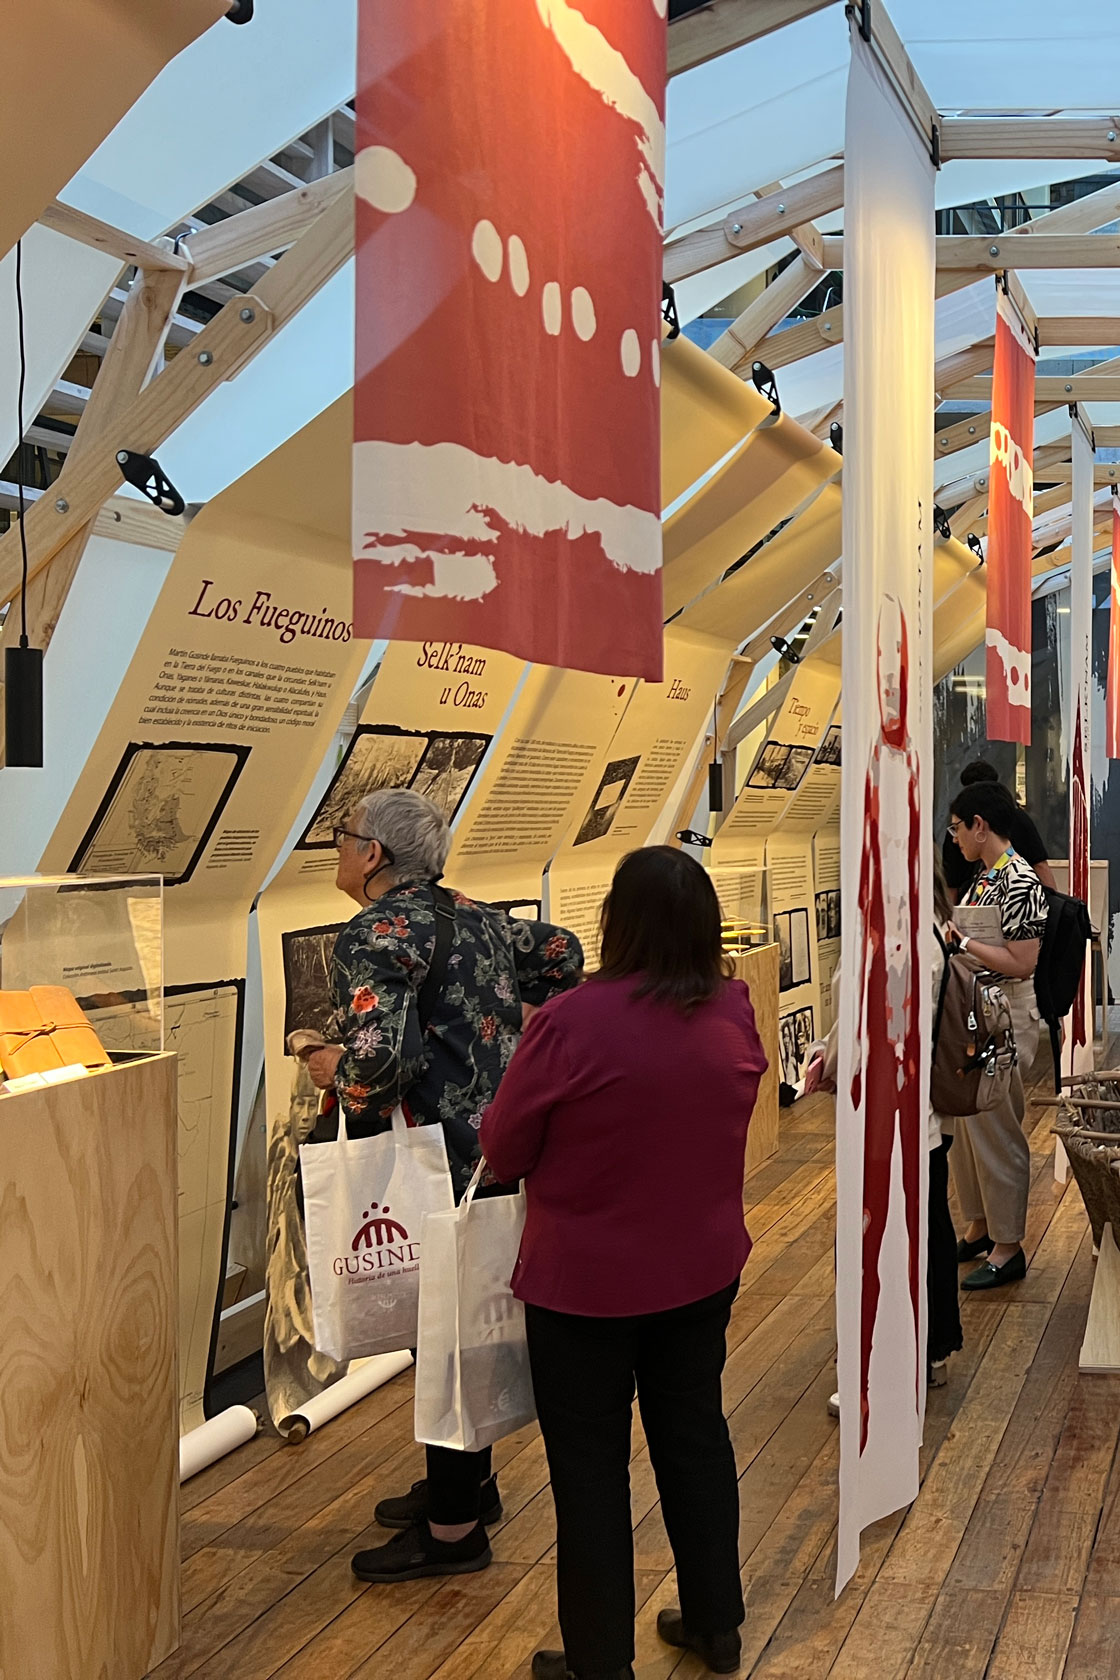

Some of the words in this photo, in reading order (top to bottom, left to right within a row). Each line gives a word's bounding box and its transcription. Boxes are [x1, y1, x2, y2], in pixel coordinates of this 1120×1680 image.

[188, 579, 242, 623] Los
[242, 591, 353, 644] Fueguinos
[416, 641, 487, 677] Selk'nam
[181, 661, 196, 670] Tierra
[206, 664, 222, 674] Fuego
[244, 670, 265, 678] canales
[153, 682, 177, 692] Aunque
[216, 688, 236, 697] culturas
[439, 687, 450, 705] u
[453, 681, 488, 709] Onas
[666, 679, 691, 701] Haus
[216, 709, 228, 718] Dios
[138, 716, 152, 724] bien
[225, 722, 238, 730] ritos
[377, 1270, 386, 1280] de
[387, 1268, 401, 1277] una
